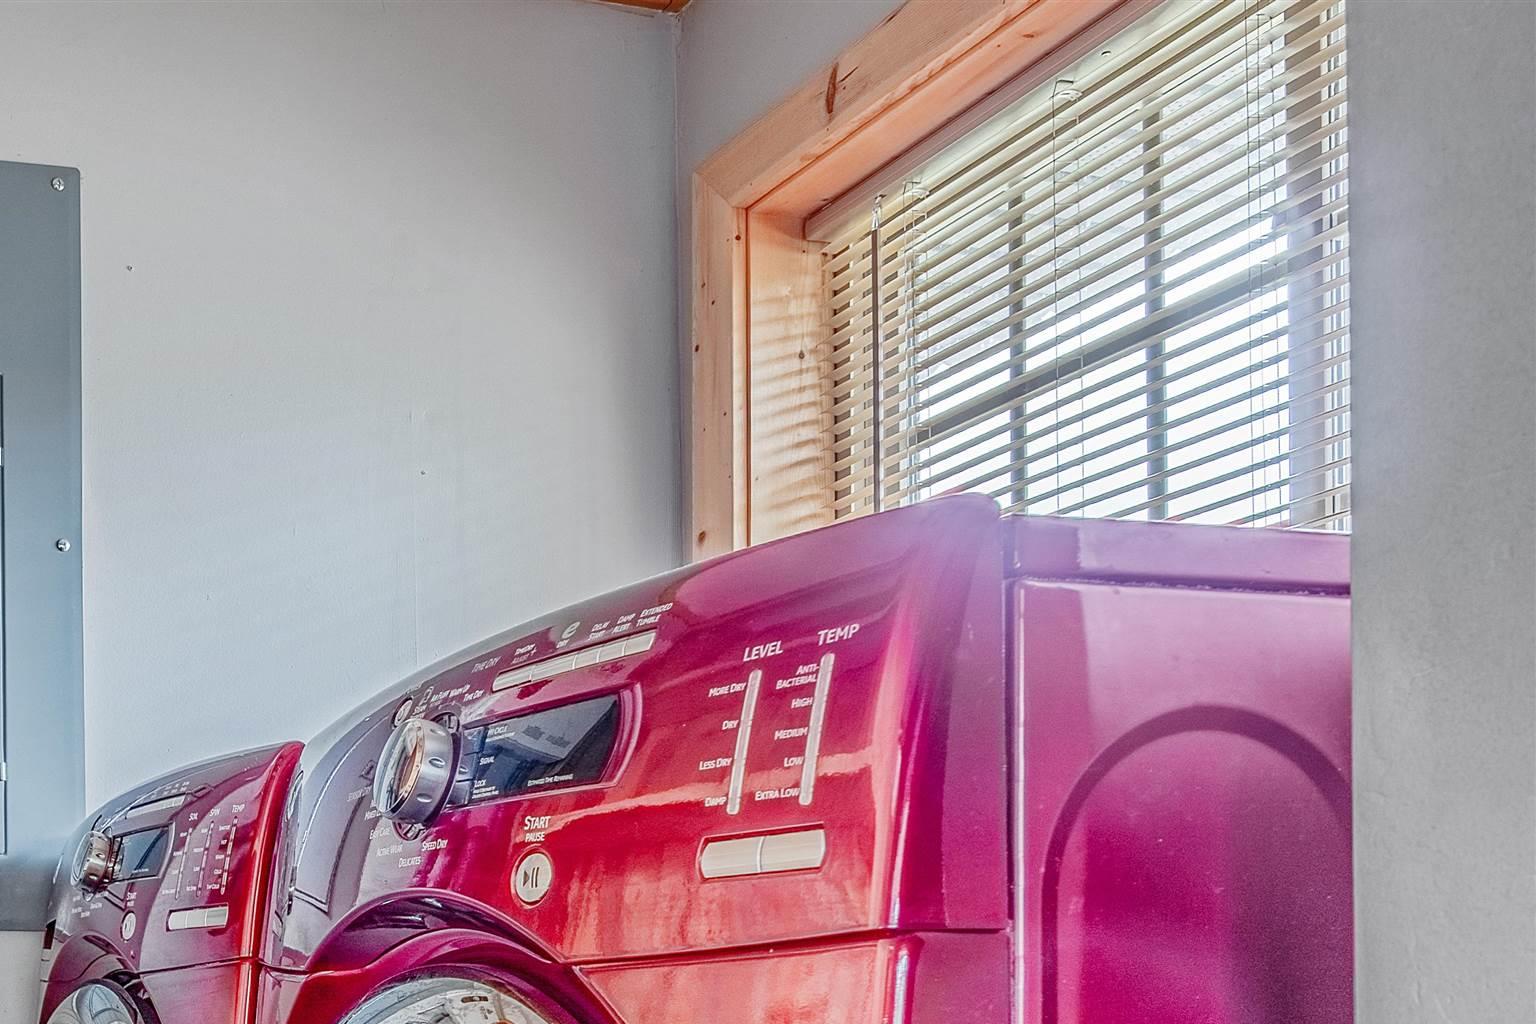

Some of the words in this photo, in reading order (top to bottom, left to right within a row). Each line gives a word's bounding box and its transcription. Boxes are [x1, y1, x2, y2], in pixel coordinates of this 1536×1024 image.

[817, 623, 861, 646] TEMP
[743, 640, 784, 662] LEVEL
[776, 674, 818, 690] BACTERIAL
[708, 684, 729, 697] MORE
[730, 682, 747, 693] DRY
[791, 697, 813, 709] HIGH
[722, 719, 739, 730] DRY
[774, 726, 808, 740] MEDIUM
[699, 759, 716, 771] LESS
[716, 757, 733, 768] DRY
[784, 756, 805, 767] LOW
[755, 789, 779, 801] EXTRA
[780, 787, 800, 799] LOW
[524, 815, 552, 830] START
[524, 831, 546, 843] PAUSE
